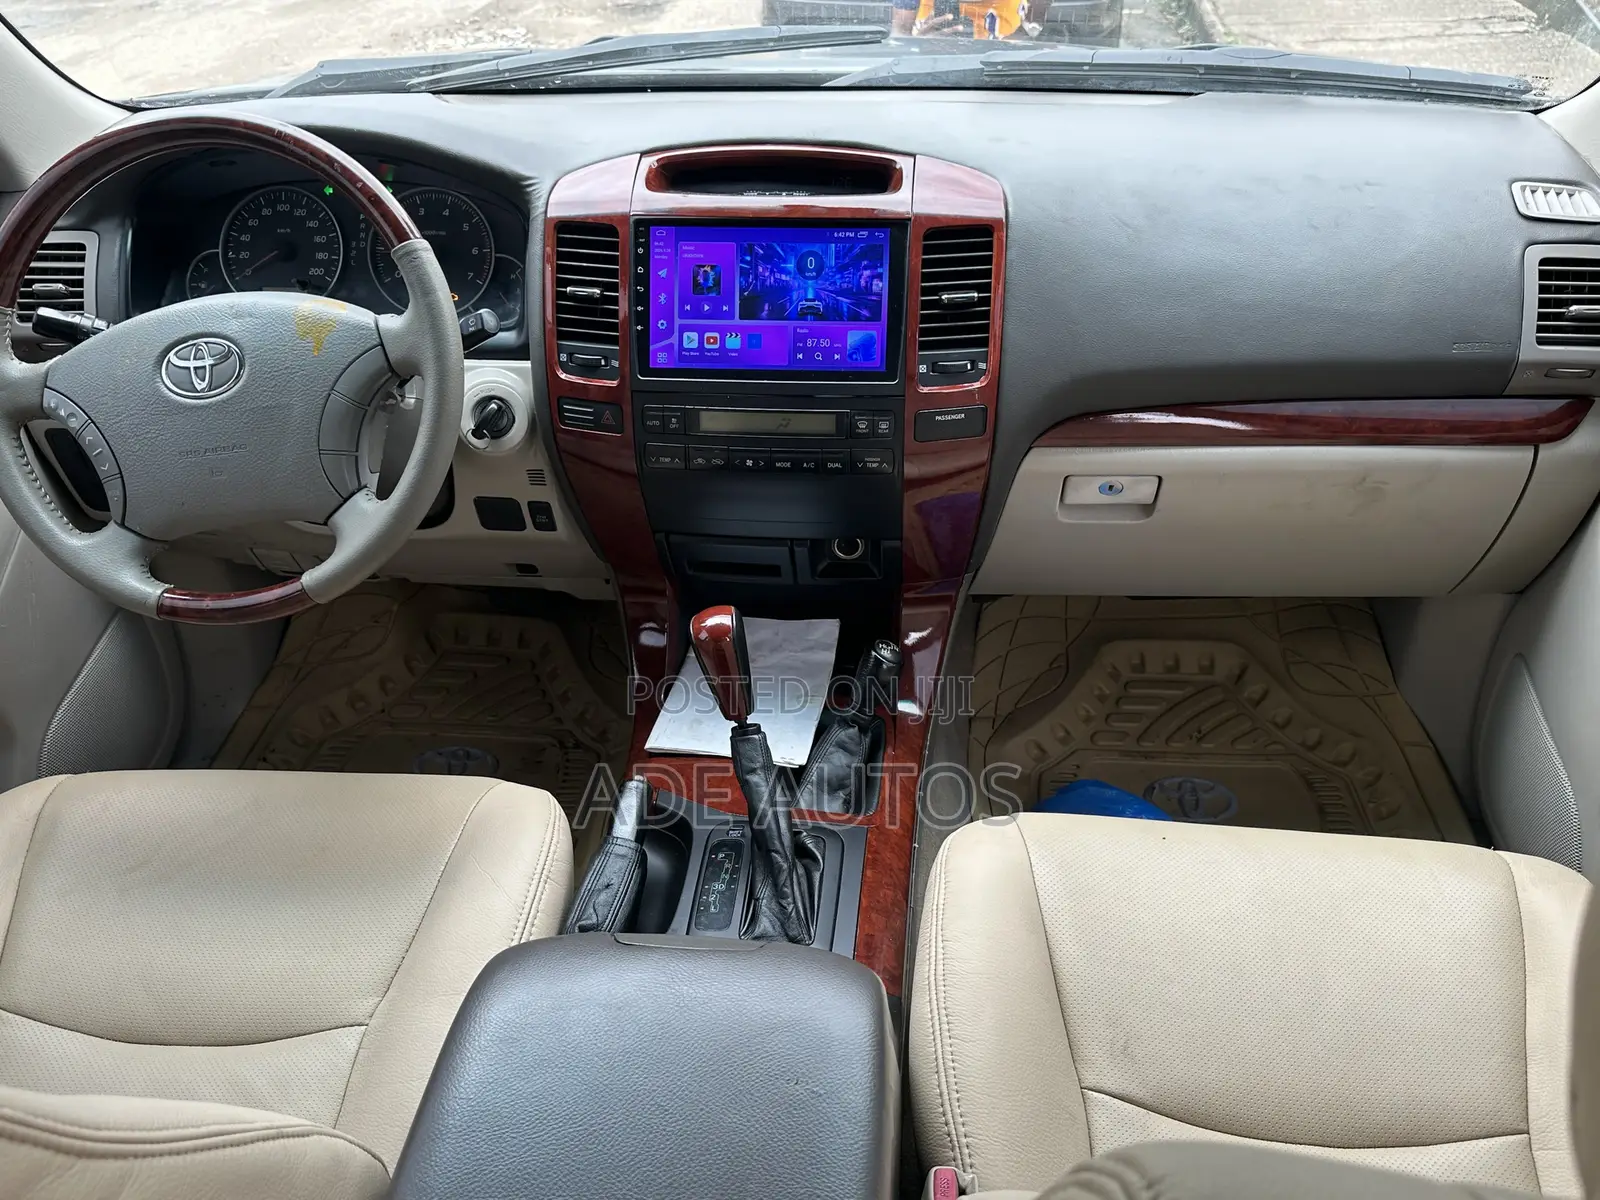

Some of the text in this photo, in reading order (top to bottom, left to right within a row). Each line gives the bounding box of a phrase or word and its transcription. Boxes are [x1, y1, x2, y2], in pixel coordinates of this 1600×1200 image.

[261, 208, 272, 216] 80
[418, 208, 425, 216] 3
[442, 208, 449, 216] 4
[306, 220, 319, 228] 140
[462, 223, 469, 231] 5
[240, 234, 251, 242] 40
[313, 235, 327, 243] 160
[239, 251, 250, 259] 20
[472, 247, 479, 255] 6
[315, 252, 329, 260] 180
[807, 256, 815, 269] 0
[467, 272, 474, 280] 7
[806, 338, 831, 348] 87.50
[935, 413, 965, 421] PASSENGER
[939, 1177, 950, 1198] PRESS
